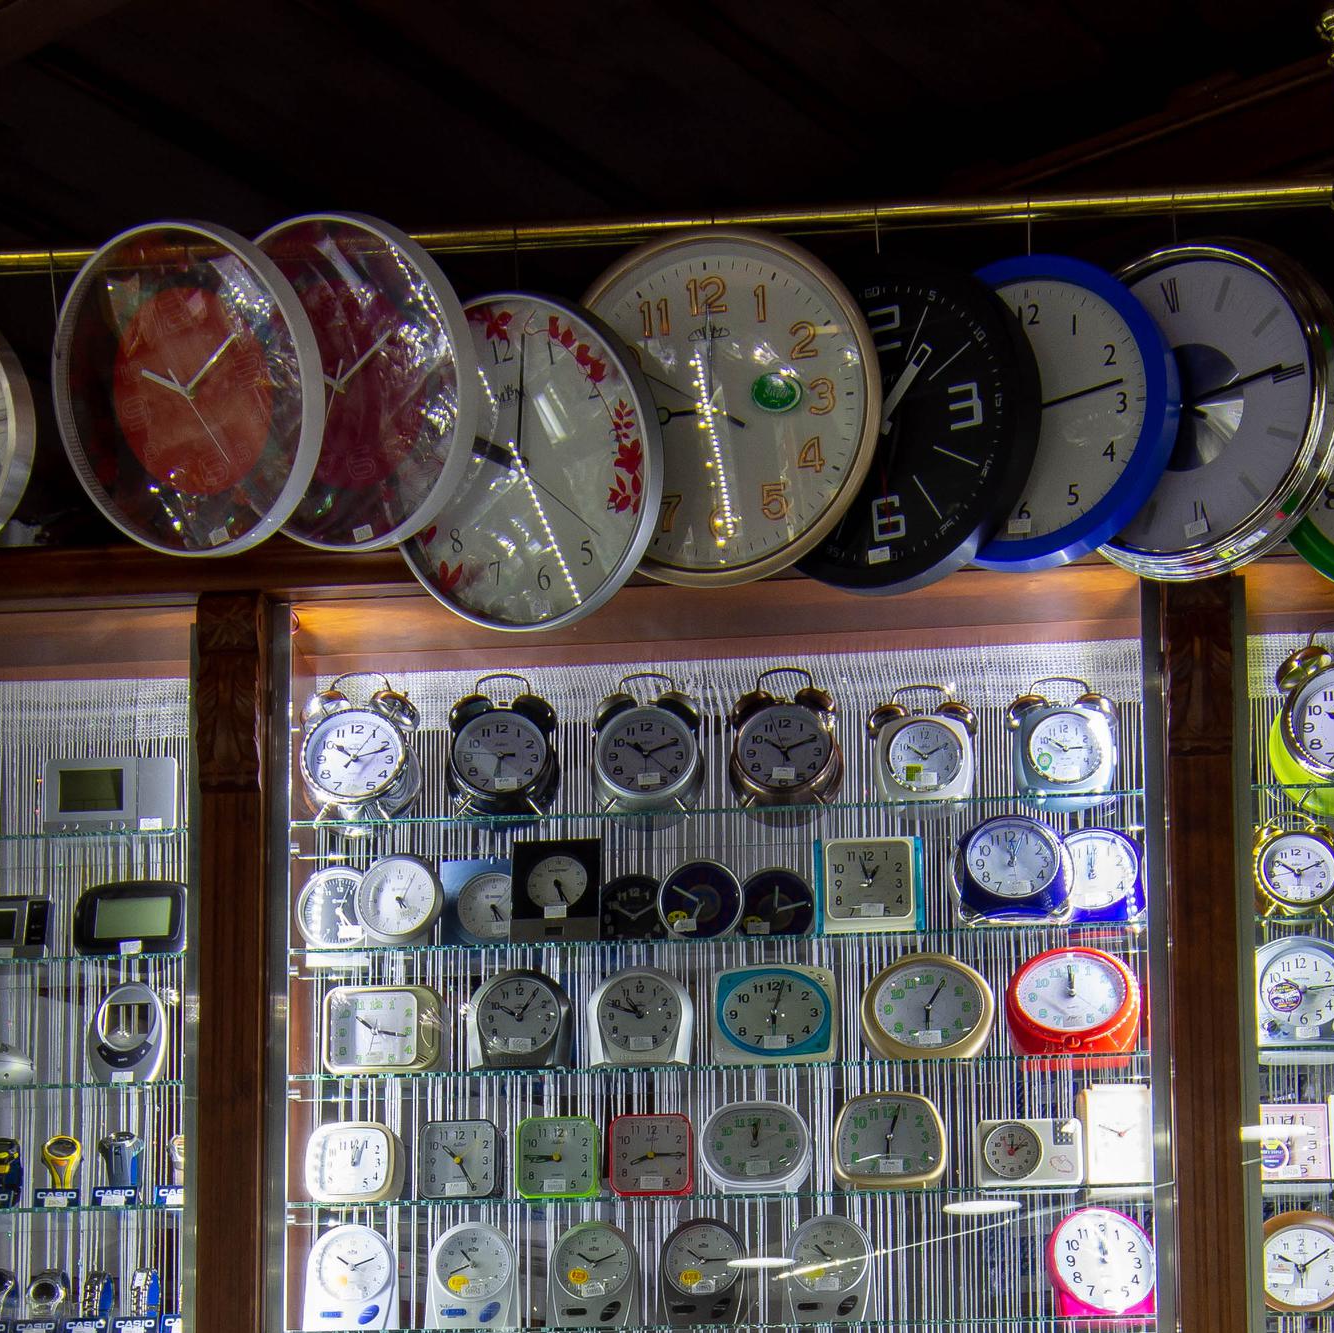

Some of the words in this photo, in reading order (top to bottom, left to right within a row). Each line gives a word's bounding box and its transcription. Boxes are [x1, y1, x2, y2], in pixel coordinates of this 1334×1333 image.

[685, 276, 727, 317] 12
[753, 284, 766, 322] 1
[639, 298, 670, 338] 11
[789, 321, 818, 360] 2
[492, 339, 514, 365] 12
[1103, 345, 1117, 366] 2
[809, 377, 835, 416] 3
[947, 381, 984, 431] 3
[1116, 392, 1128, 414] 3
[797, 435, 825, 473] 4
[1103, 441, 1116, 462] 4
[761, 482, 789, 520] 5
[1068, 484, 1080, 506] 5
[871, 495, 906, 541] 6
[449, 527, 464, 554] 8
[581, 540, 593, 566] 5
[488, 561, 502, 586] 7
[537, 565, 551, 591] 6
[1308, 705, 1322, 717] 10
[351, 724, 364, 734] 12
[1309, 739, 1322, 750] 8
[863, 851, 874, 862] 12
[833, 863, 844, 874] 10
[37, 1191, 76, 1200] CASIO
[95, 1189, 135, 1198] CASIO
[1065, 1240, 1079, 1251] 10
[1127, 1242, 1135, 1253] 2
[1066, 1255, 1076, 1267] 9
[1073, 1272, 1082, 1283] 8
[17, 1323, 55, 1331] CASIO
[115, 1320, 154, 1328] CASIO
